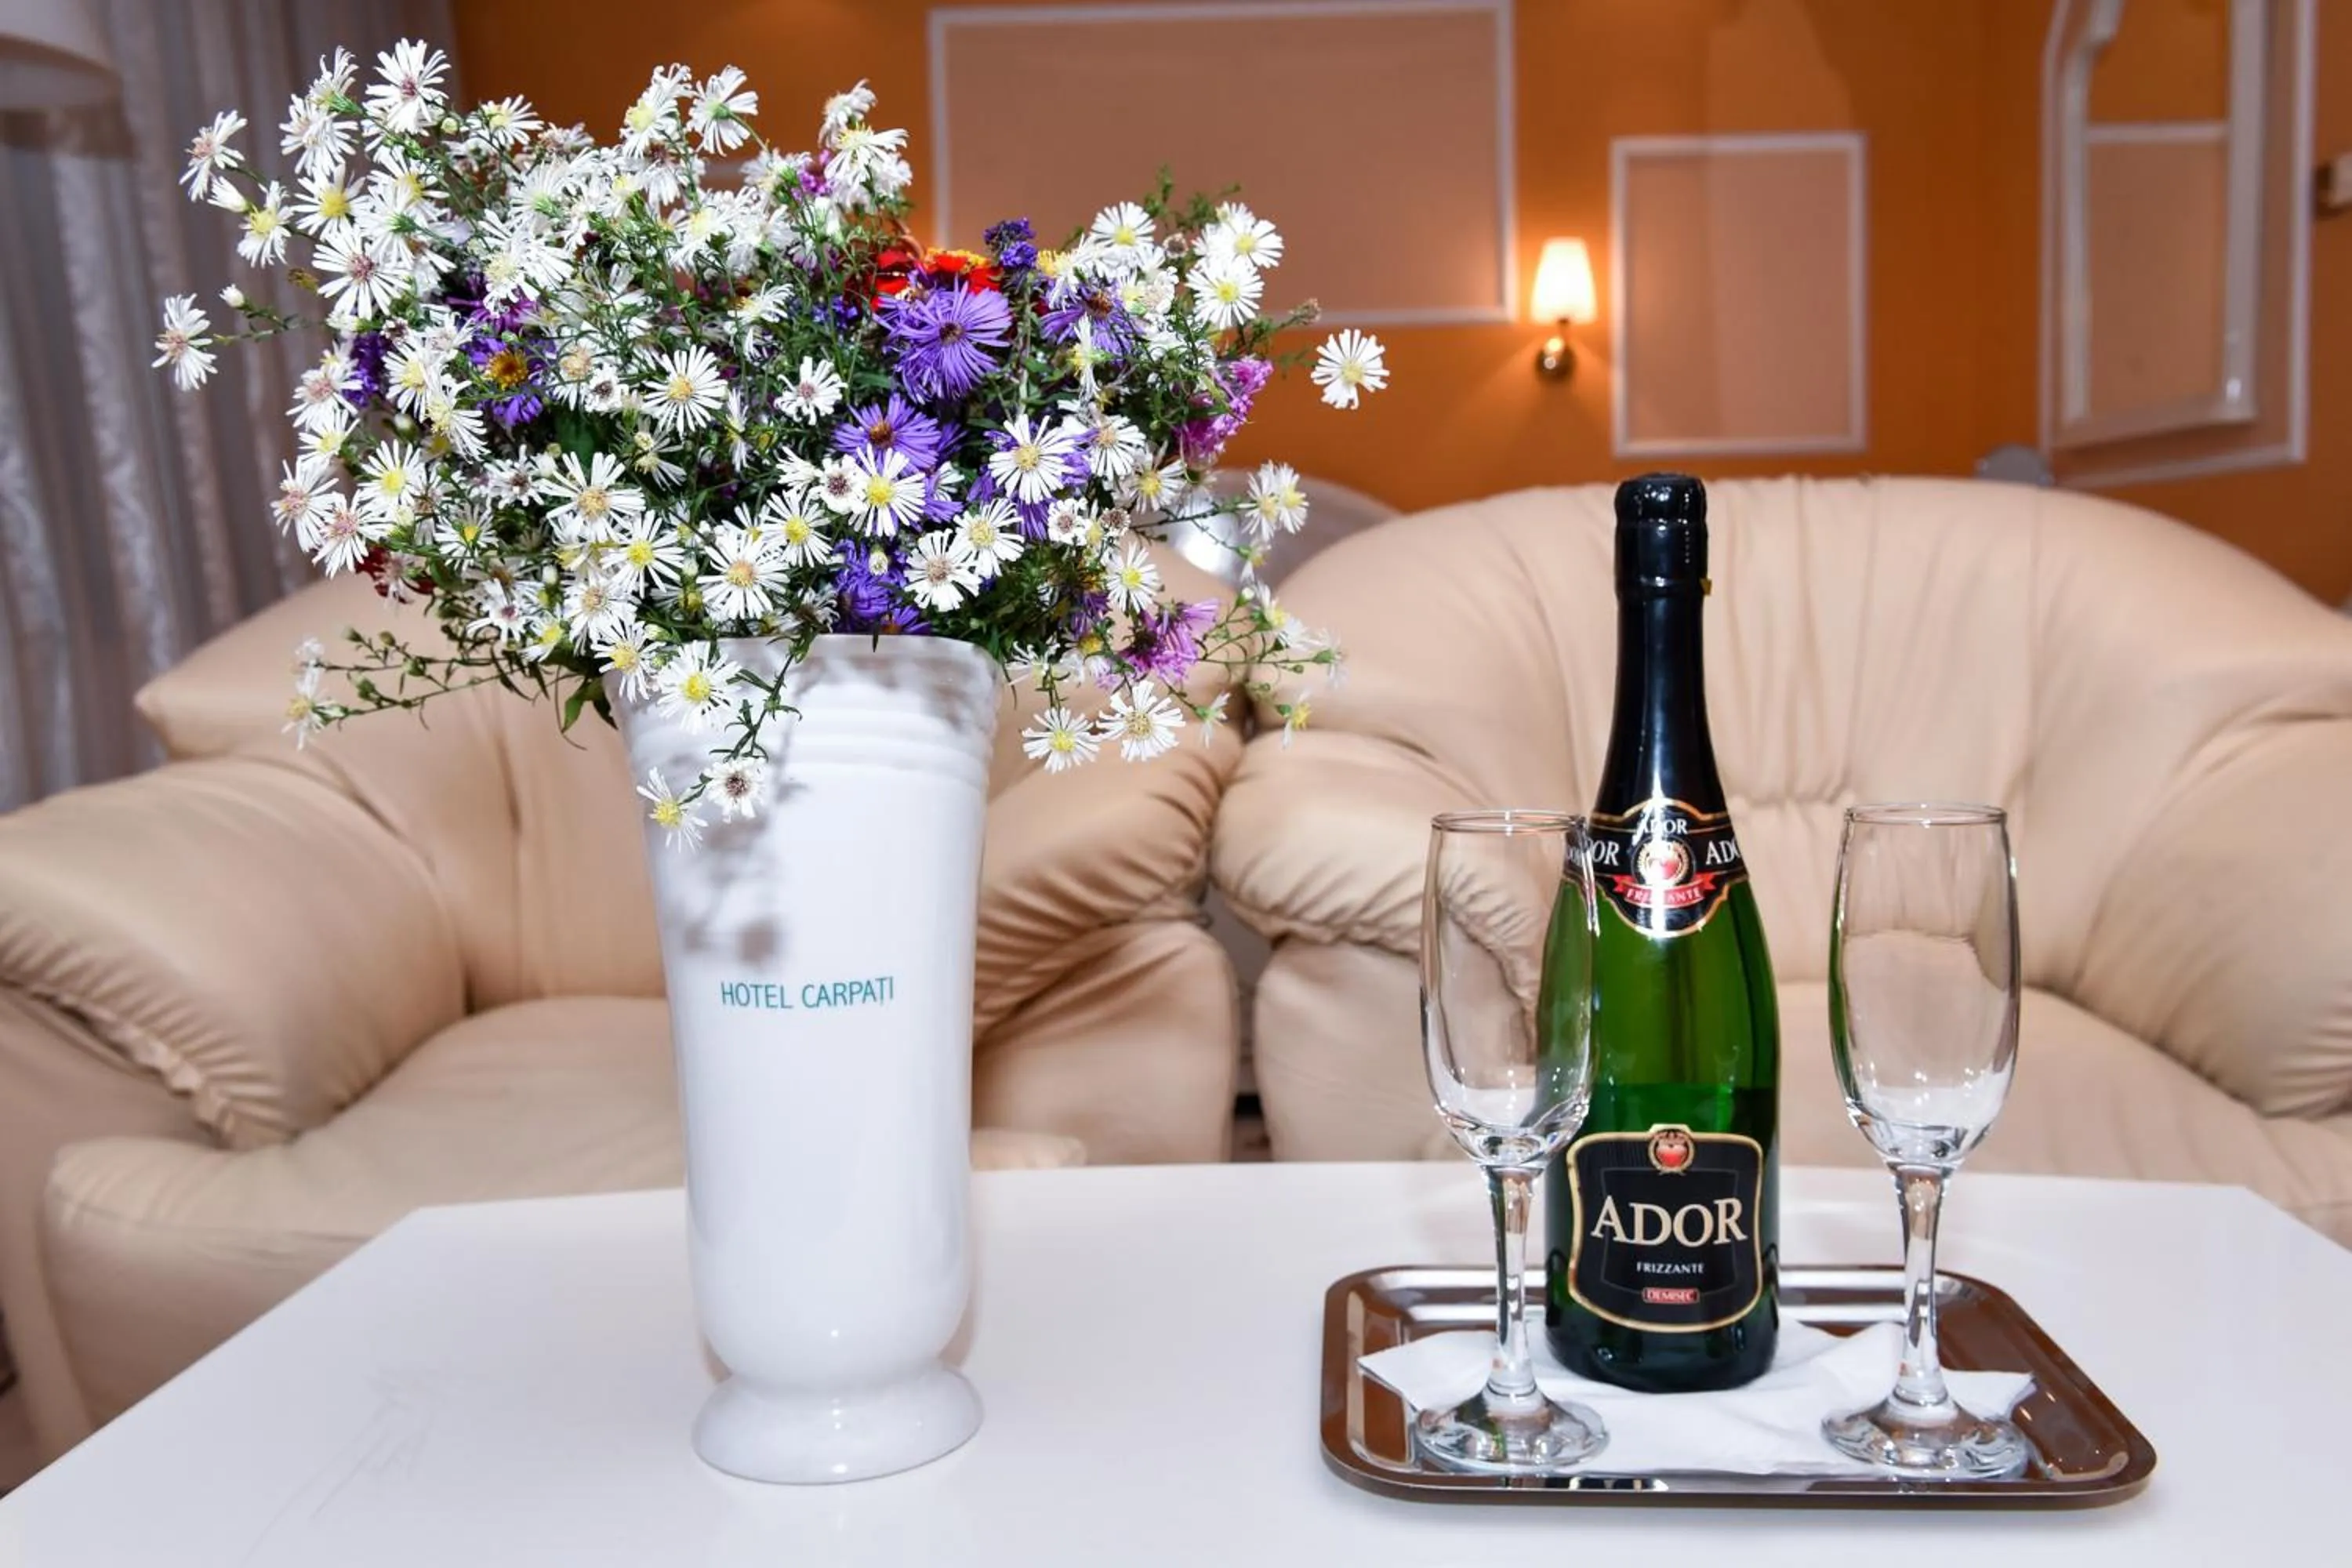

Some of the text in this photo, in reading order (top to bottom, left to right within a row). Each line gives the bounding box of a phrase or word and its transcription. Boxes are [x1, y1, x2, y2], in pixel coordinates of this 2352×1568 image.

[1626, 887, 1700, 904] FRIANTE
[720, 982, 793, 1009] HOTEL
[1590, 1195, 1748, 1247] ADOR
[1636, 1261, 1705, 1274] FRIZZANTE
